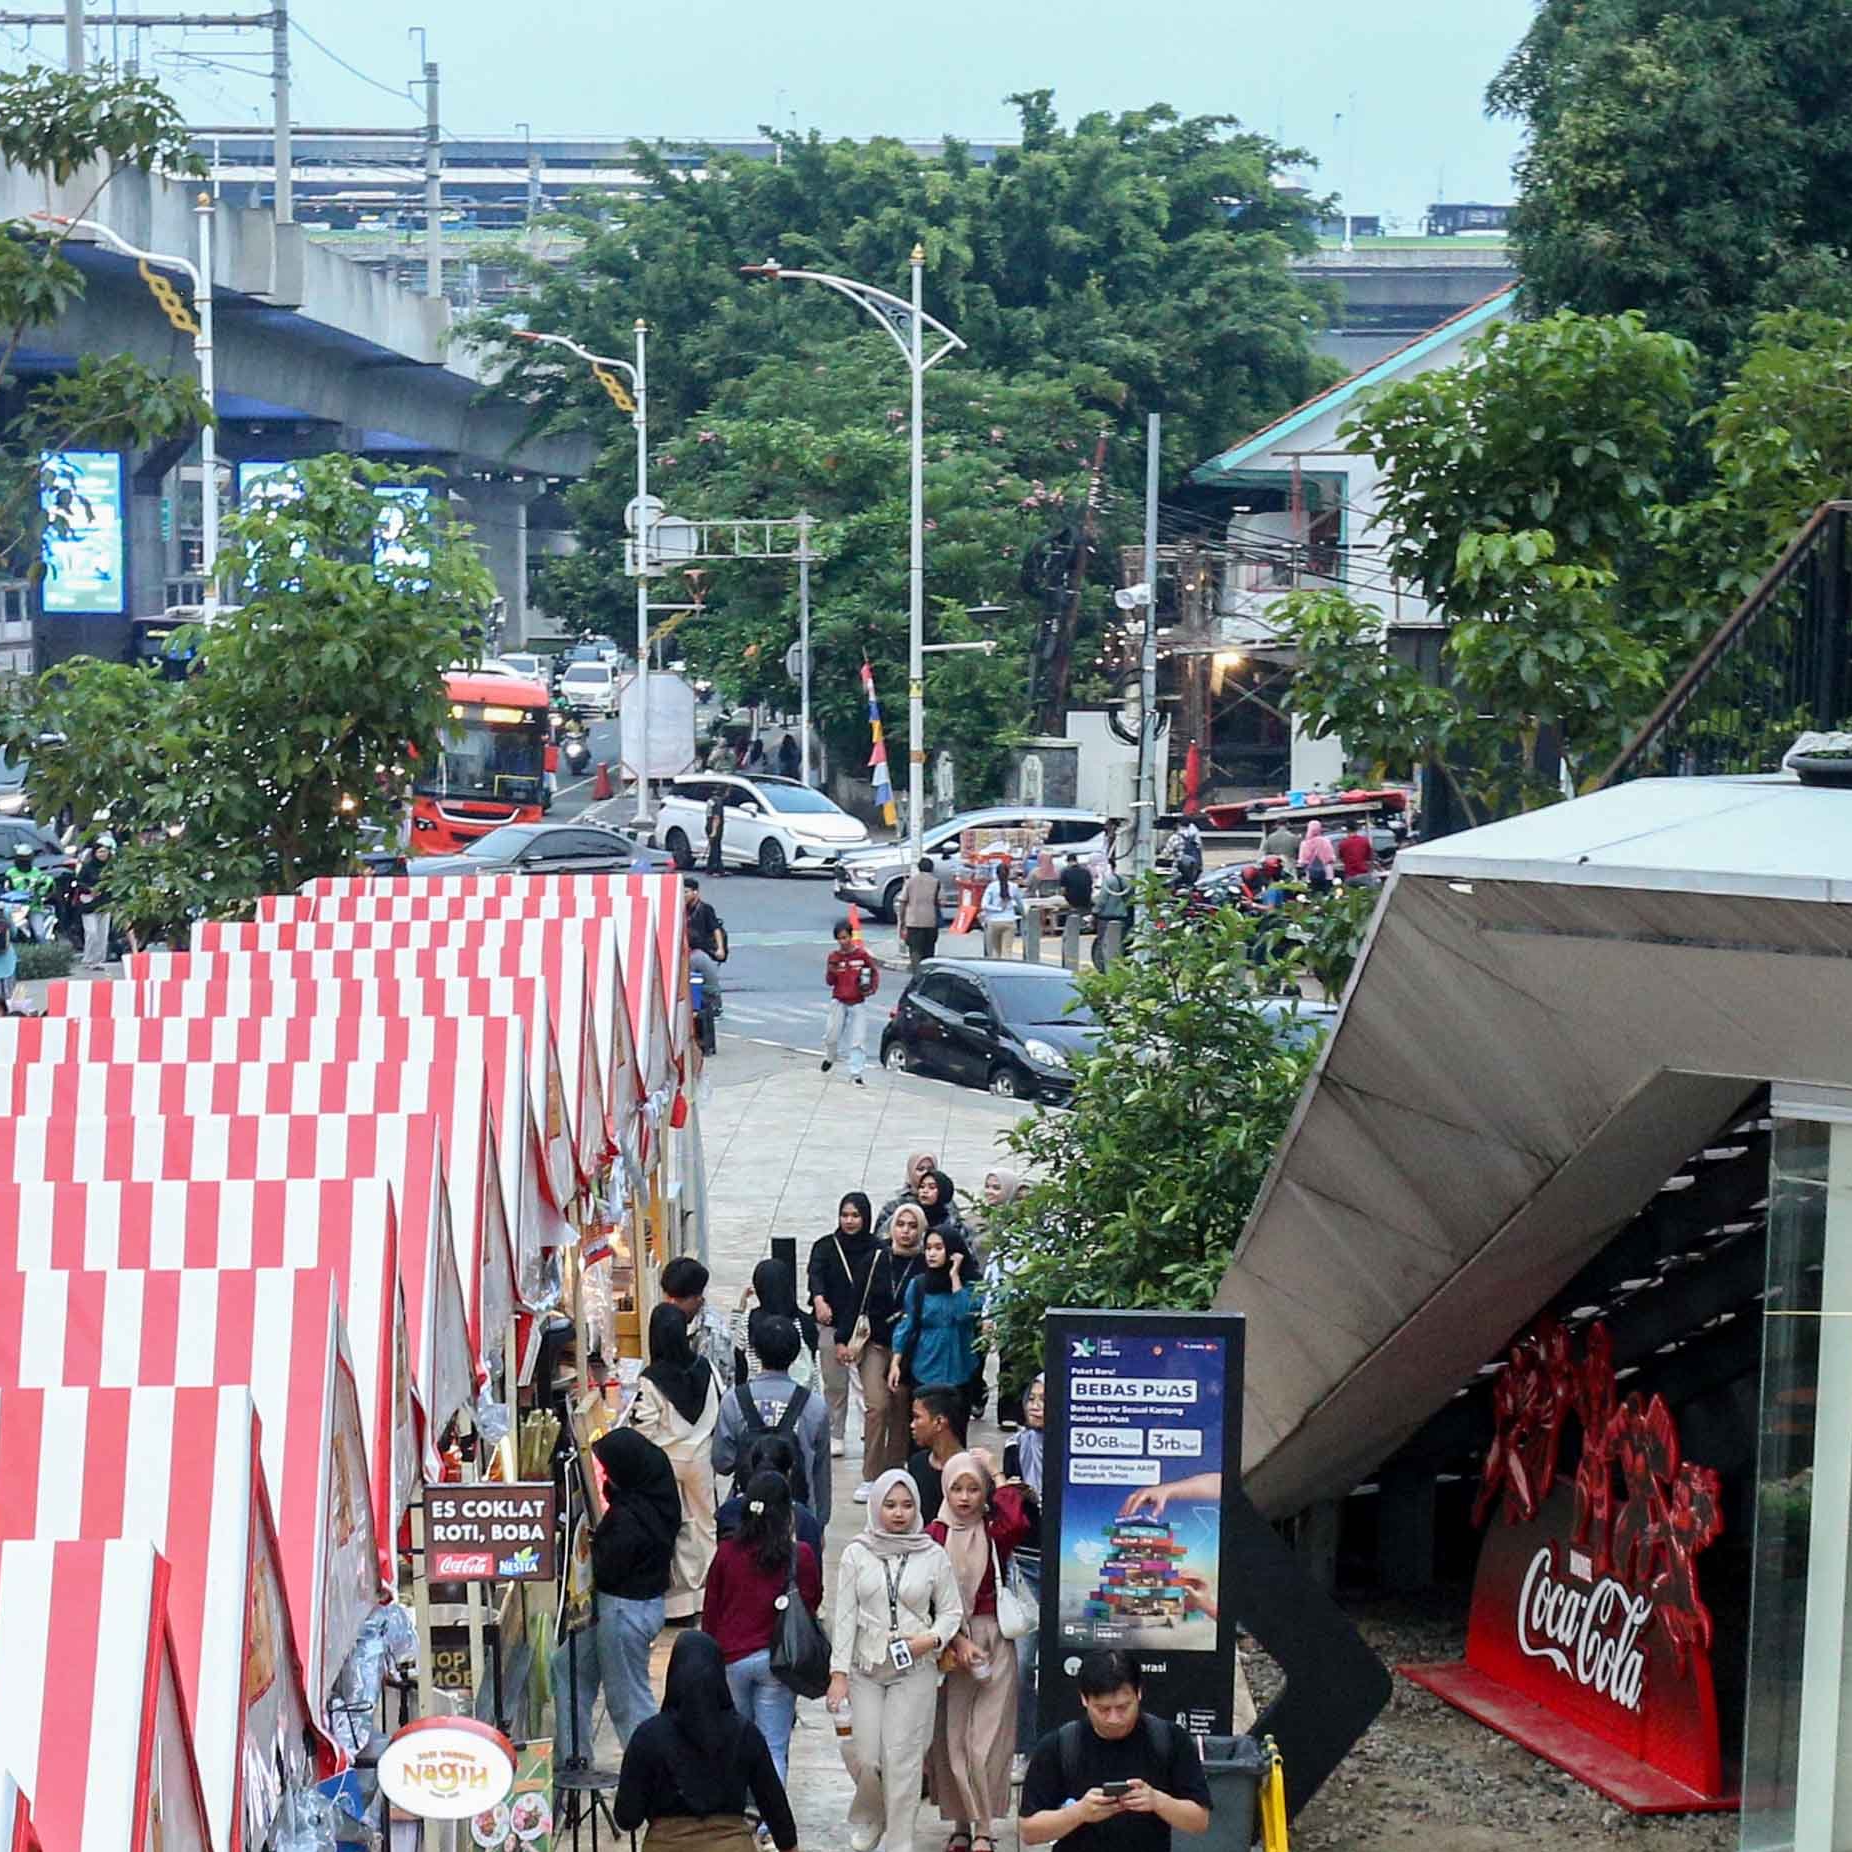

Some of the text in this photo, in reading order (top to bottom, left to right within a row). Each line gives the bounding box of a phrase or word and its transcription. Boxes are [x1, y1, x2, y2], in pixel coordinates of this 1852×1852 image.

[1075, 1383, 1193, 1398] BEBAS PUAS
[1074, 1432, 1119, 1448] 30GB
[1152, 1434, 1181, 1450] 3rb
[431, 1500, 545, 1518] ES COKLAT
[433, 1524, 545, 1543] ROTI, BOBA
